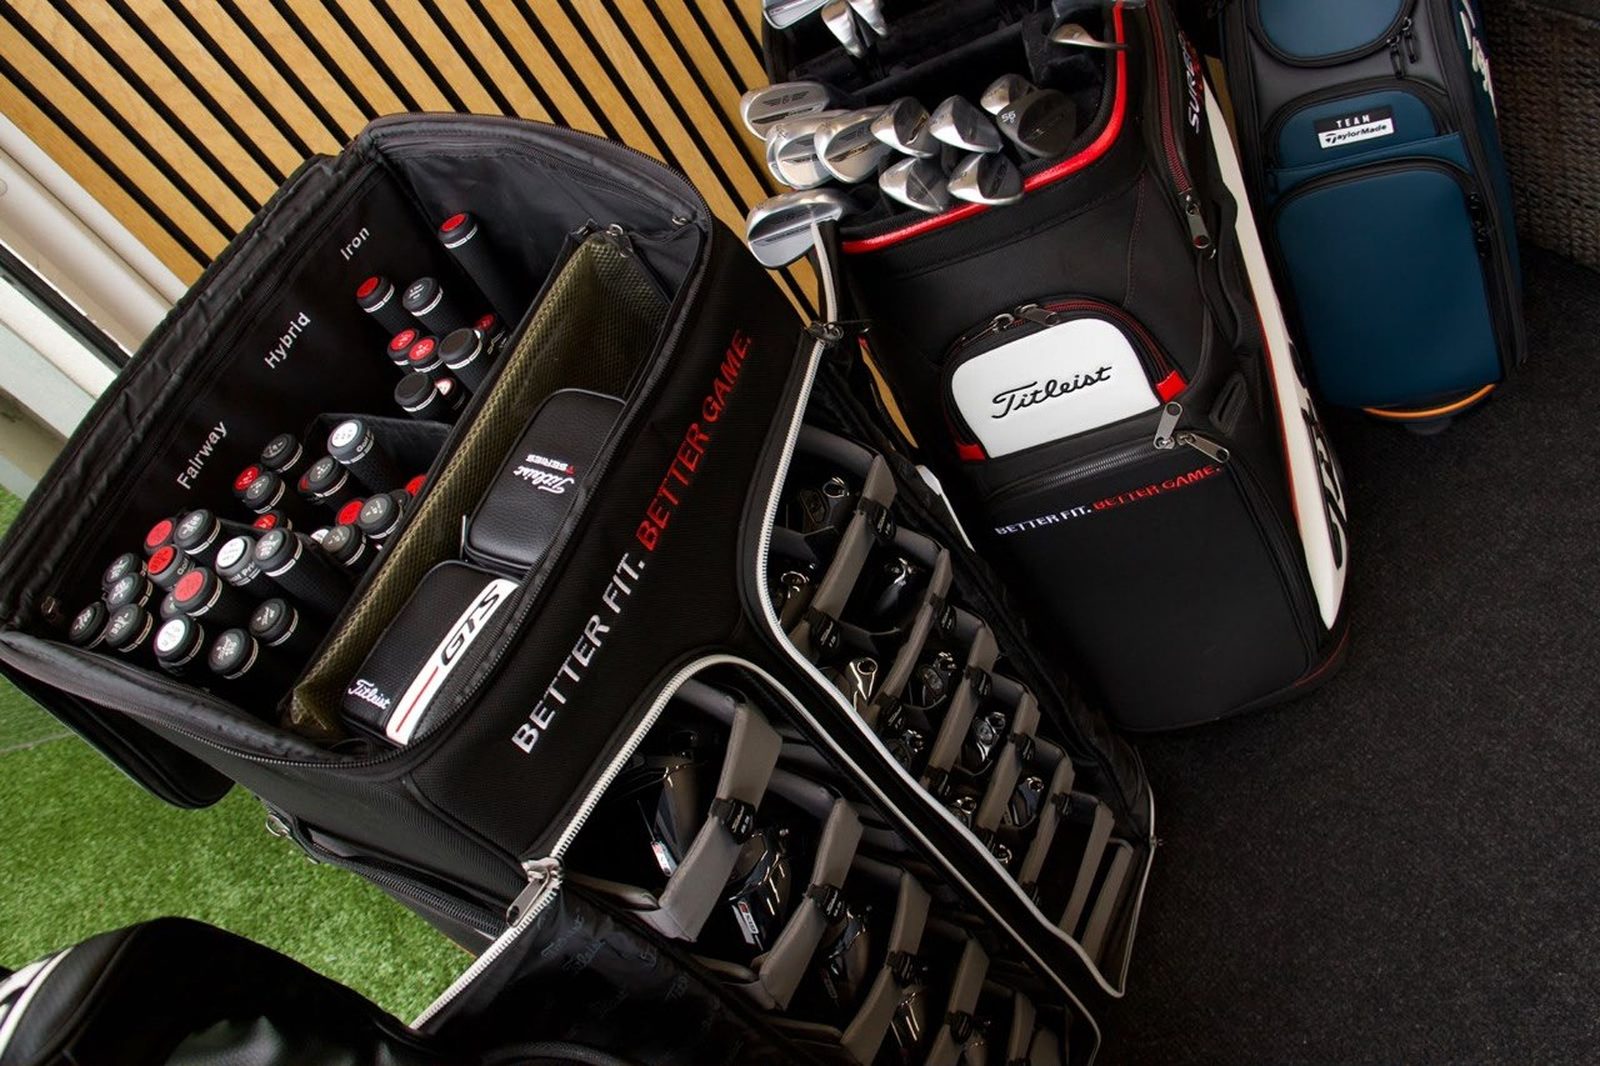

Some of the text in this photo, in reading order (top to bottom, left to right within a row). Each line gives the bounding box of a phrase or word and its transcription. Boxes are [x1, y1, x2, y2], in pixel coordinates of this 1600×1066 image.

[1325, 124, 1387, 143] TaylorMade
[1336, 114, 1370, 128] TEAM
[340, 225, 370, 261] Iron
[264, 312, 312, 370] Hybrid
[991, 366, 1113, 419] Titleist
[176, 421, 229, 490] Fairway
[994, 464, 1222, 536] BETTER FIT. BETTER GAME.
[511, 329, 753, 754] BETTER FIT. BETTER GAME.
[348, 679, 390, 711] Titleist
